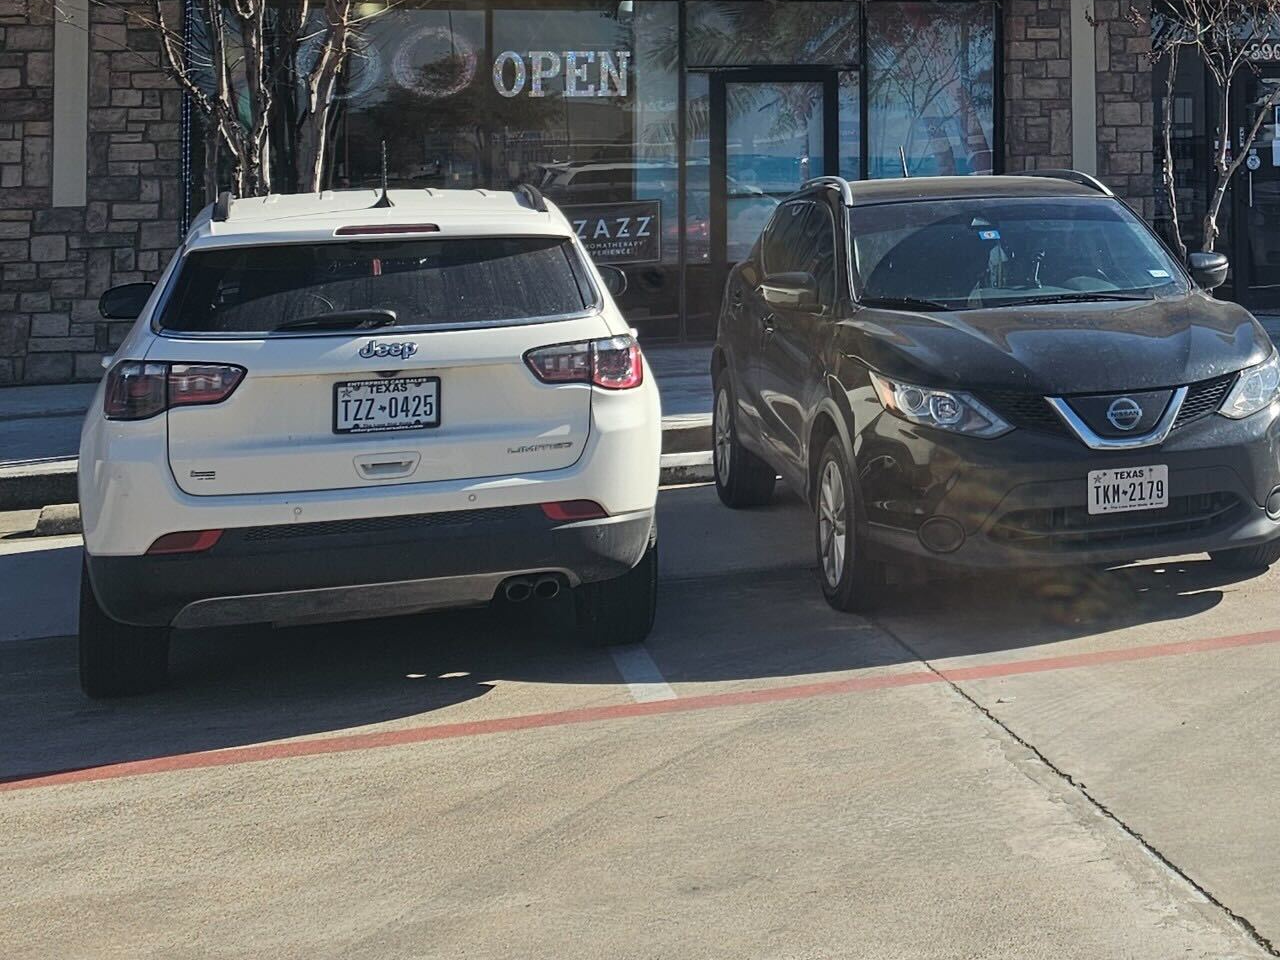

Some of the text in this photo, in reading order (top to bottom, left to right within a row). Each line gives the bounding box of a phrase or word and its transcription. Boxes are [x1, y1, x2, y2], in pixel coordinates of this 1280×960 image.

[492, 50, 632, 98] OPEN
[359, 340, 419, 360] Jeep
[369, 383, 408, 394] TEXAS
[341, 394, 433, 422] TZZ 0425
[1111, 409, 1140, 418] NISSAN
[1114, 469, 1144, 480] TEXAS
[1094, 480, 1164, 505] TKM 2179
